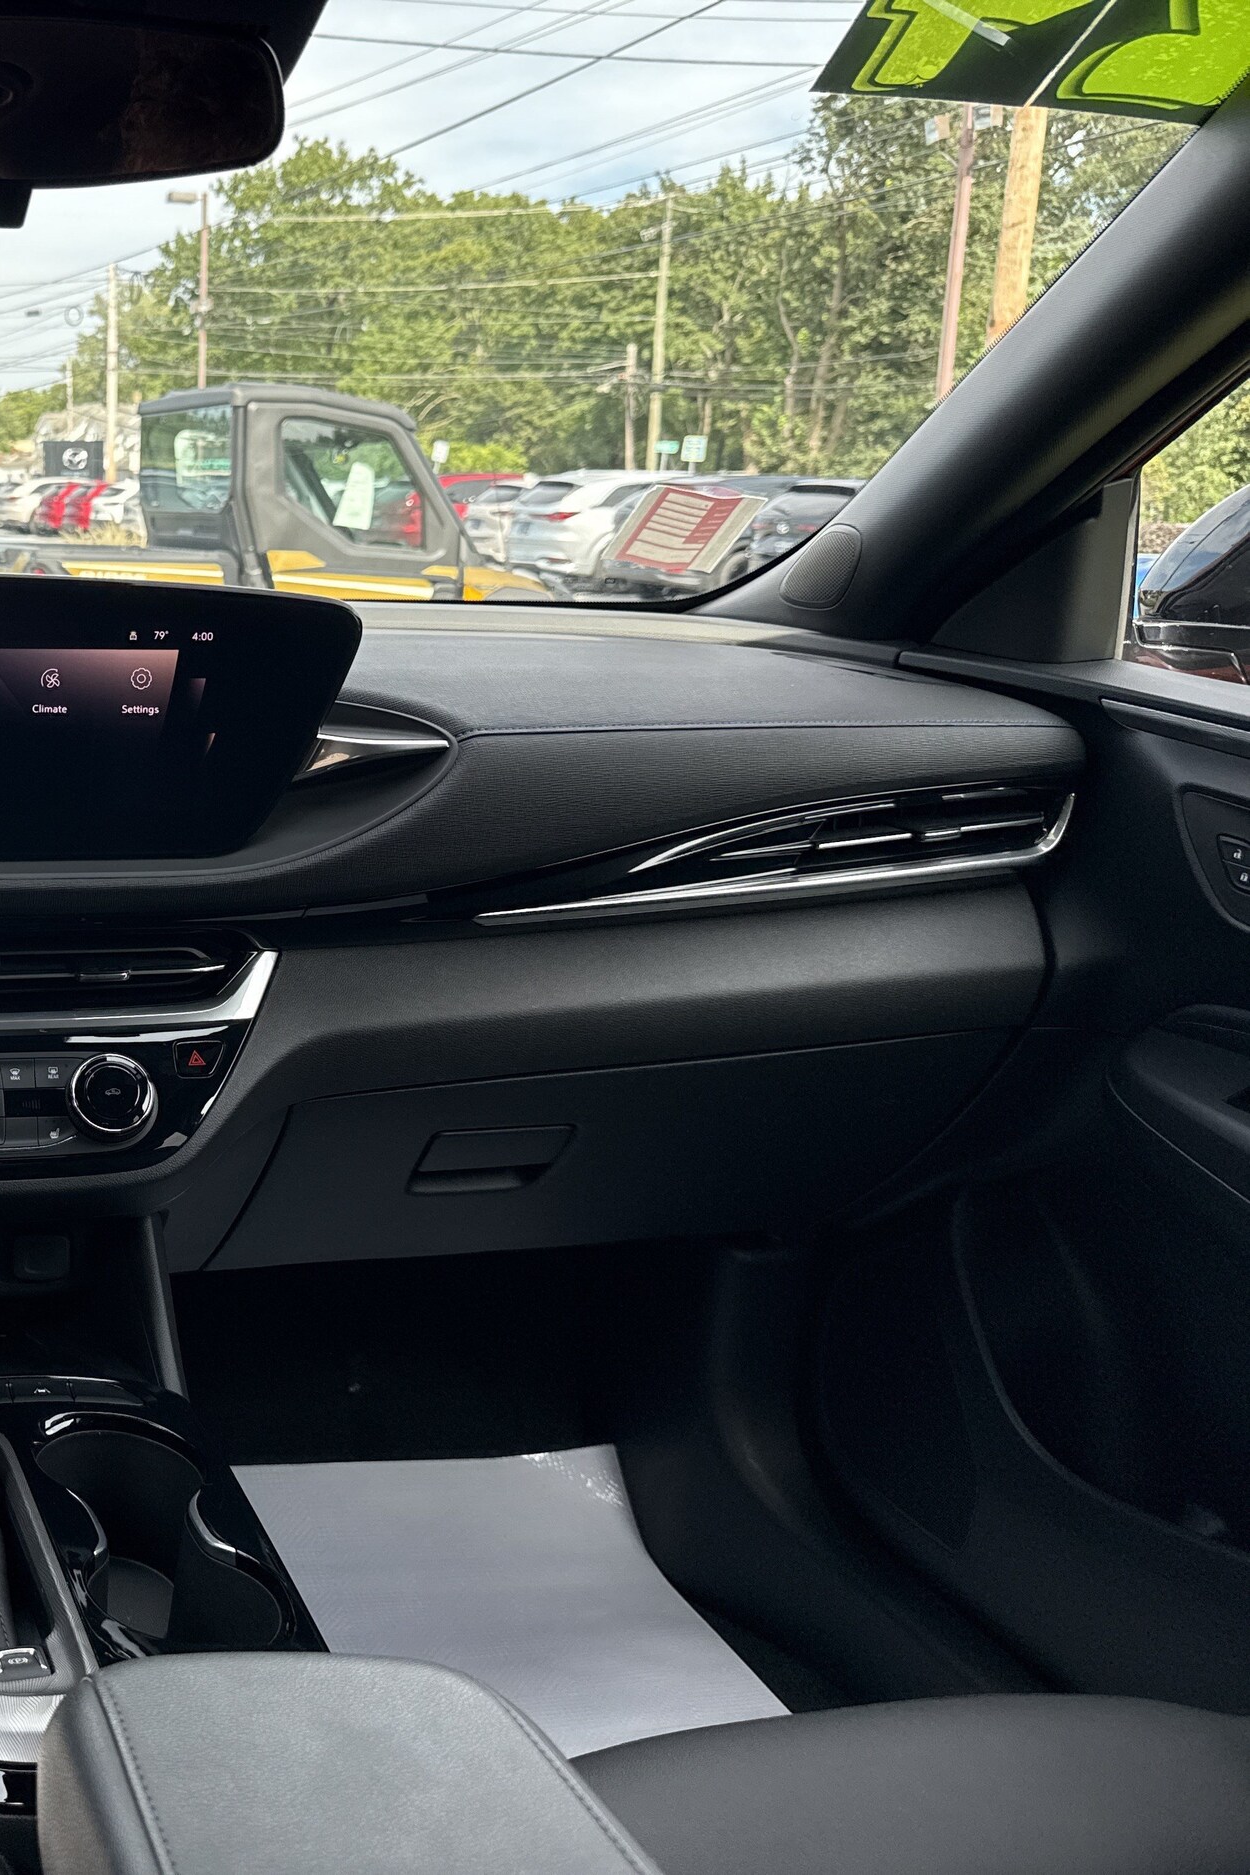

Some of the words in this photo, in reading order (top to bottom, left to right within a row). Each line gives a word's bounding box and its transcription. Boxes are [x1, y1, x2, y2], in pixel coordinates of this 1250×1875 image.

[153, 630, 169, 640] 79°
[191, 631, 214, 641] 4:00
[31, 704, 68, 714] Climate
[121, 704, 160, 716] Settings
